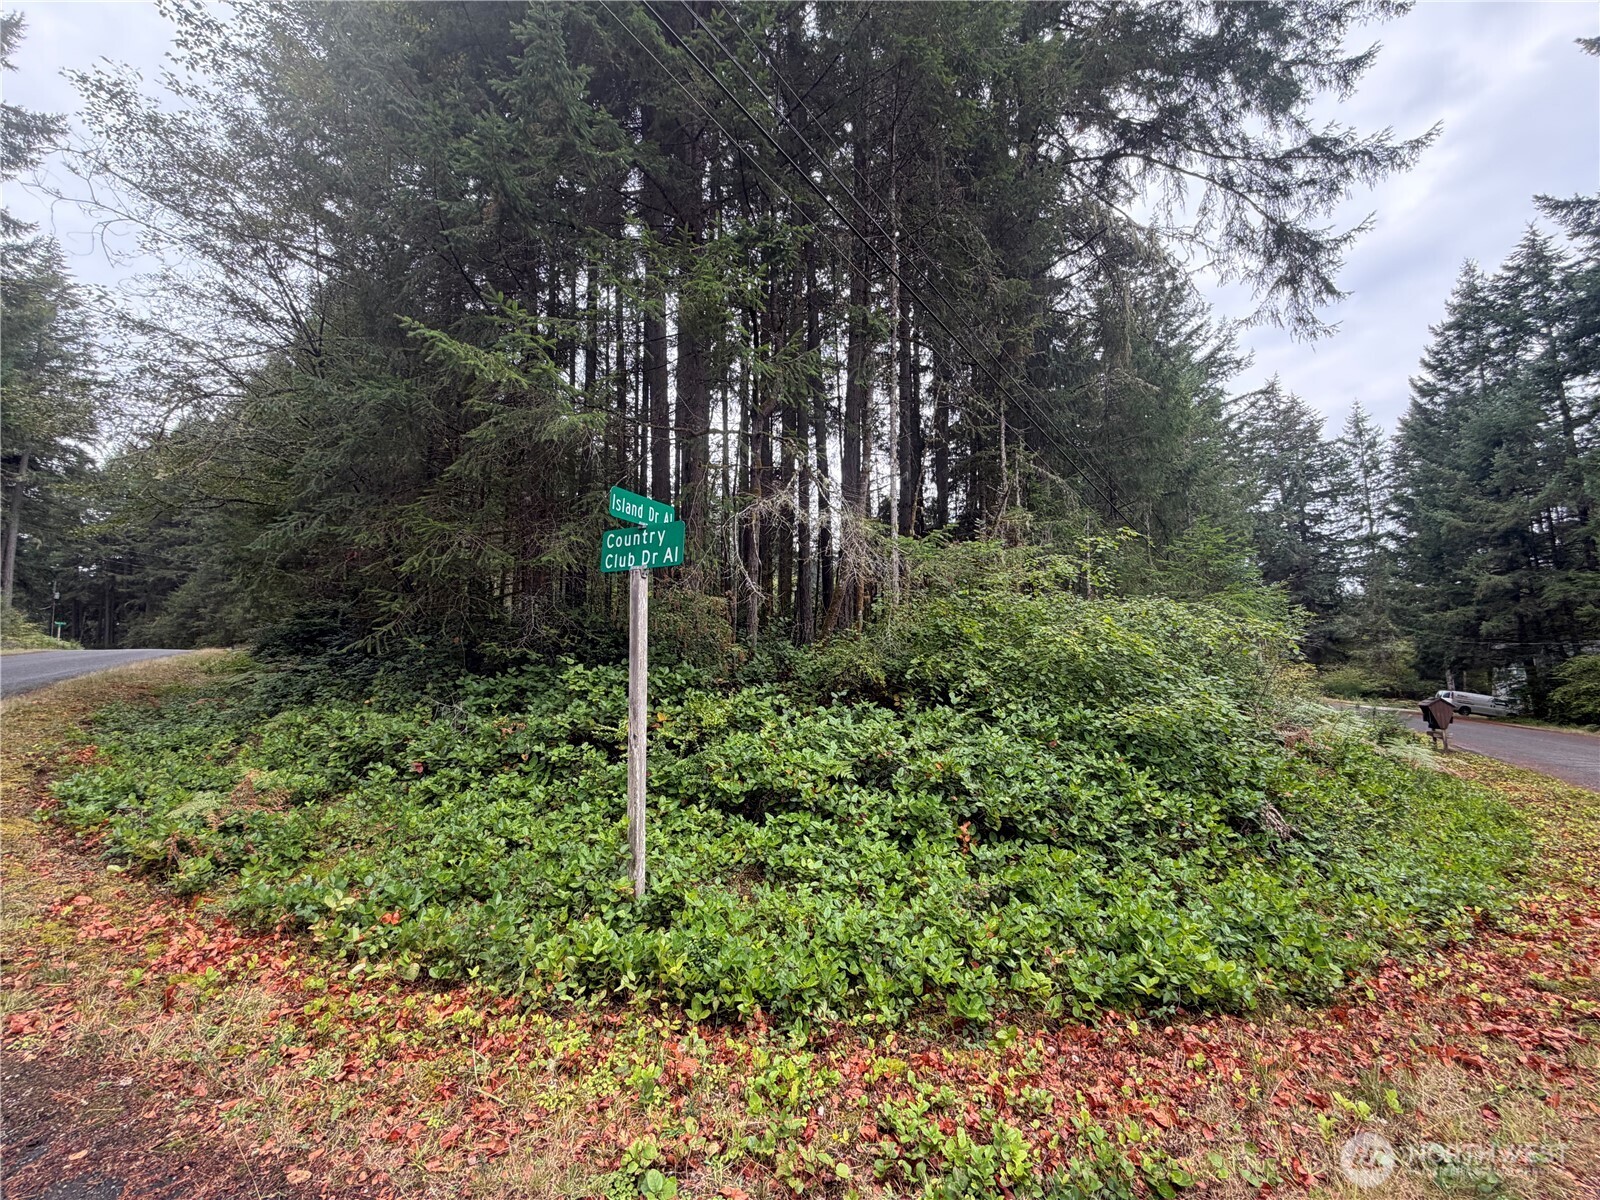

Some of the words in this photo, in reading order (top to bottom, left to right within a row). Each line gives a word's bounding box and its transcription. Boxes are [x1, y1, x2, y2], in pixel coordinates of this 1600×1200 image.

[613, 493, 643, 518] Island
[649, 507, 659, 523] Dr
[607, 530, 666, 549] Country
[605, 552, 635, 569] Club
[642, 550, 658, 566] Dr
